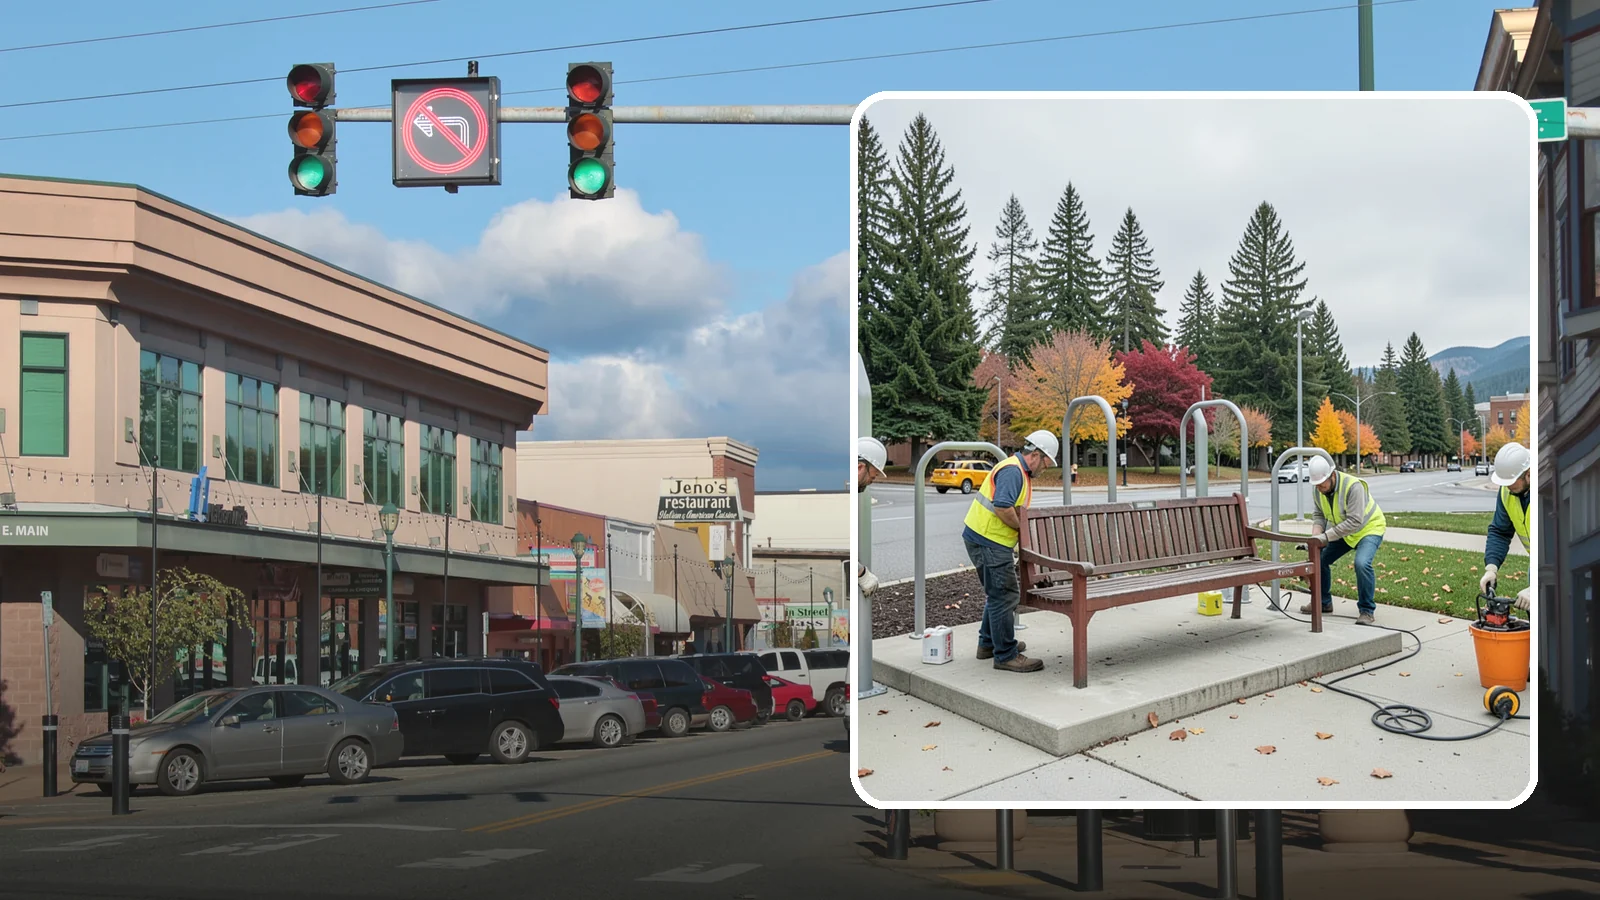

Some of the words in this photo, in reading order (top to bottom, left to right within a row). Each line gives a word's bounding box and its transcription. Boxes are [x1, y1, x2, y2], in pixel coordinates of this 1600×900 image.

[669, 480, 727, 494] Jeno's
[665, 497, 730, 508] restaurant
[658, 509, 681, 519] Italian
[686, 509, 714, 519] American
[715, 509, 737, 519] Cuisine
[2, 525, 13, 536] E.
[15, 525, 49, 536] MAIN
[786, 607, 795, 617] in
[797, 607, 829, 617] Street
